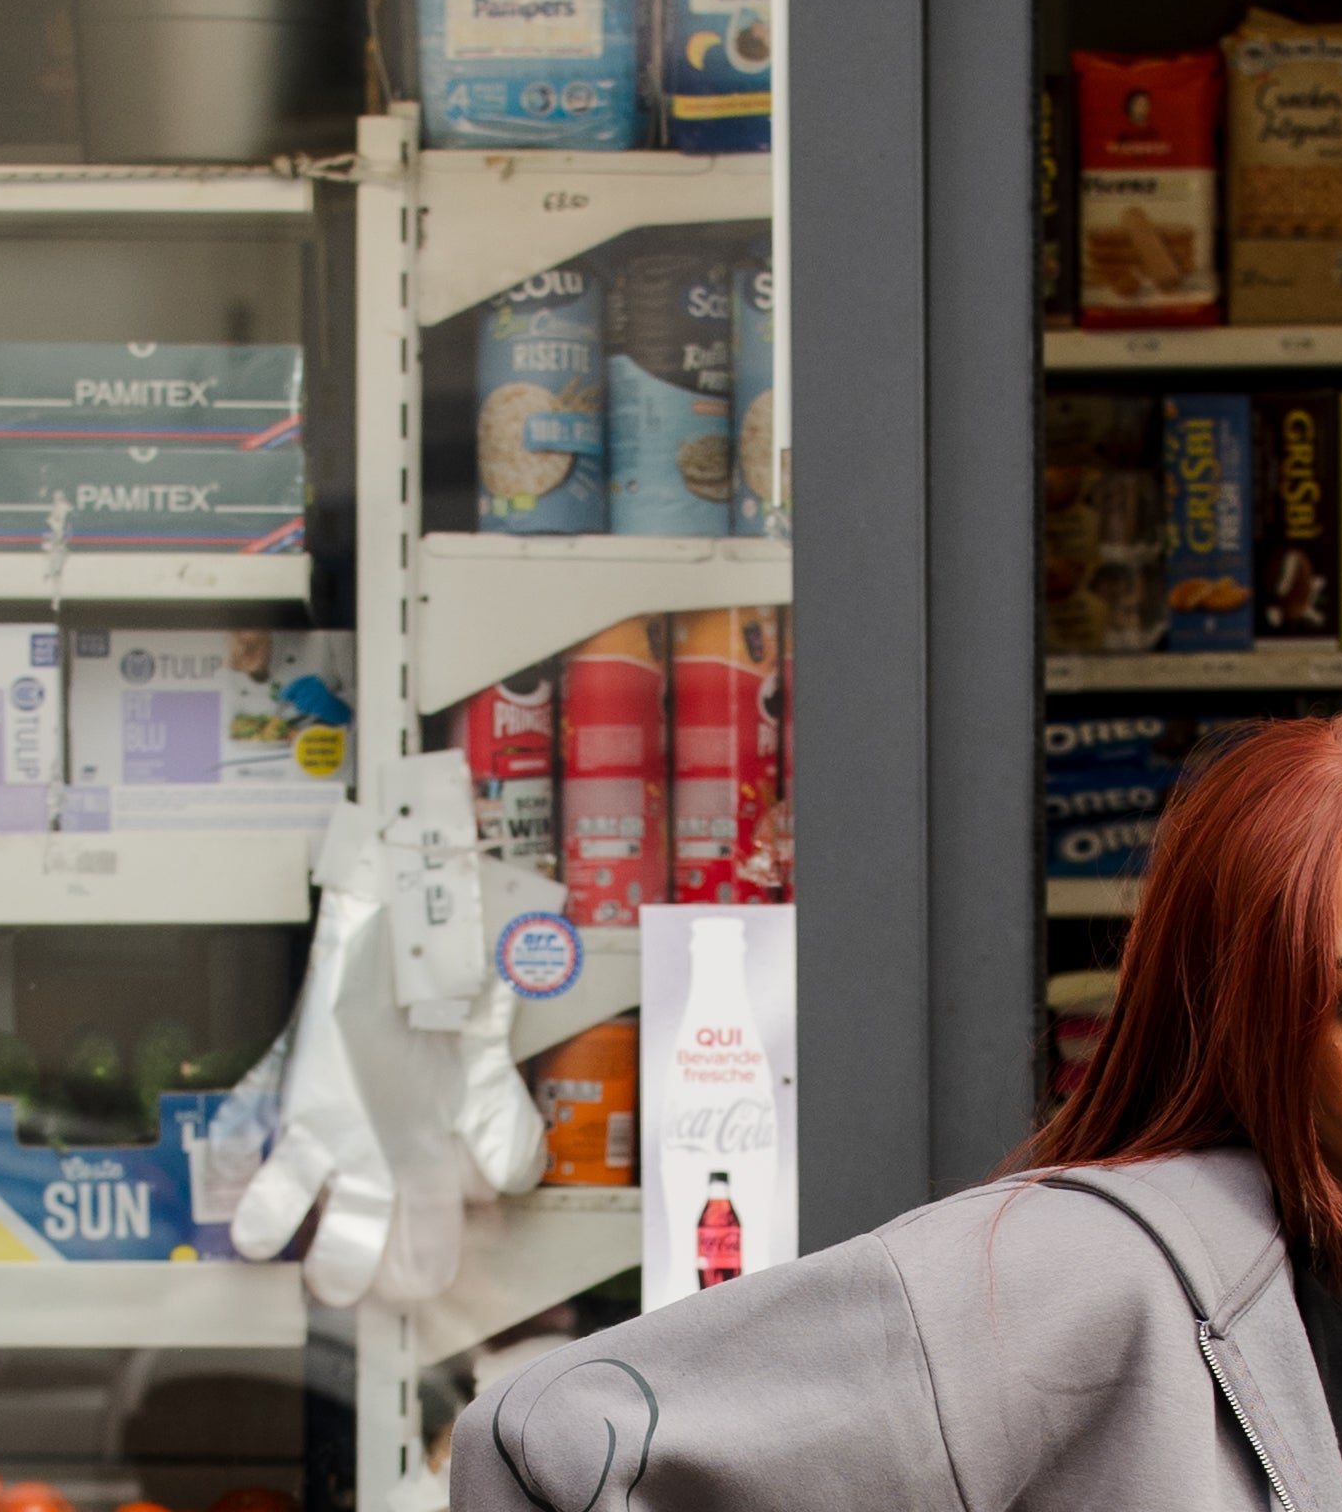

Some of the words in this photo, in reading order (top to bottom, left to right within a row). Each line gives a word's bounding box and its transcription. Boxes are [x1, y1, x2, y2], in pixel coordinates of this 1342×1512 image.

[74, 379, 210, 408] PAMITEX
[76, 484, 211, 513] PAMITEX
[157, 657, 224, 680] TULIP
[10, 716, 41, 780] TULIP
[695, 1027, 743, 1049] QUI
[676, 1049, 763, 1067] Bevande
[682, 1066, 756, 1086] fresche
[43, 1181, 152, 1241] SUN
